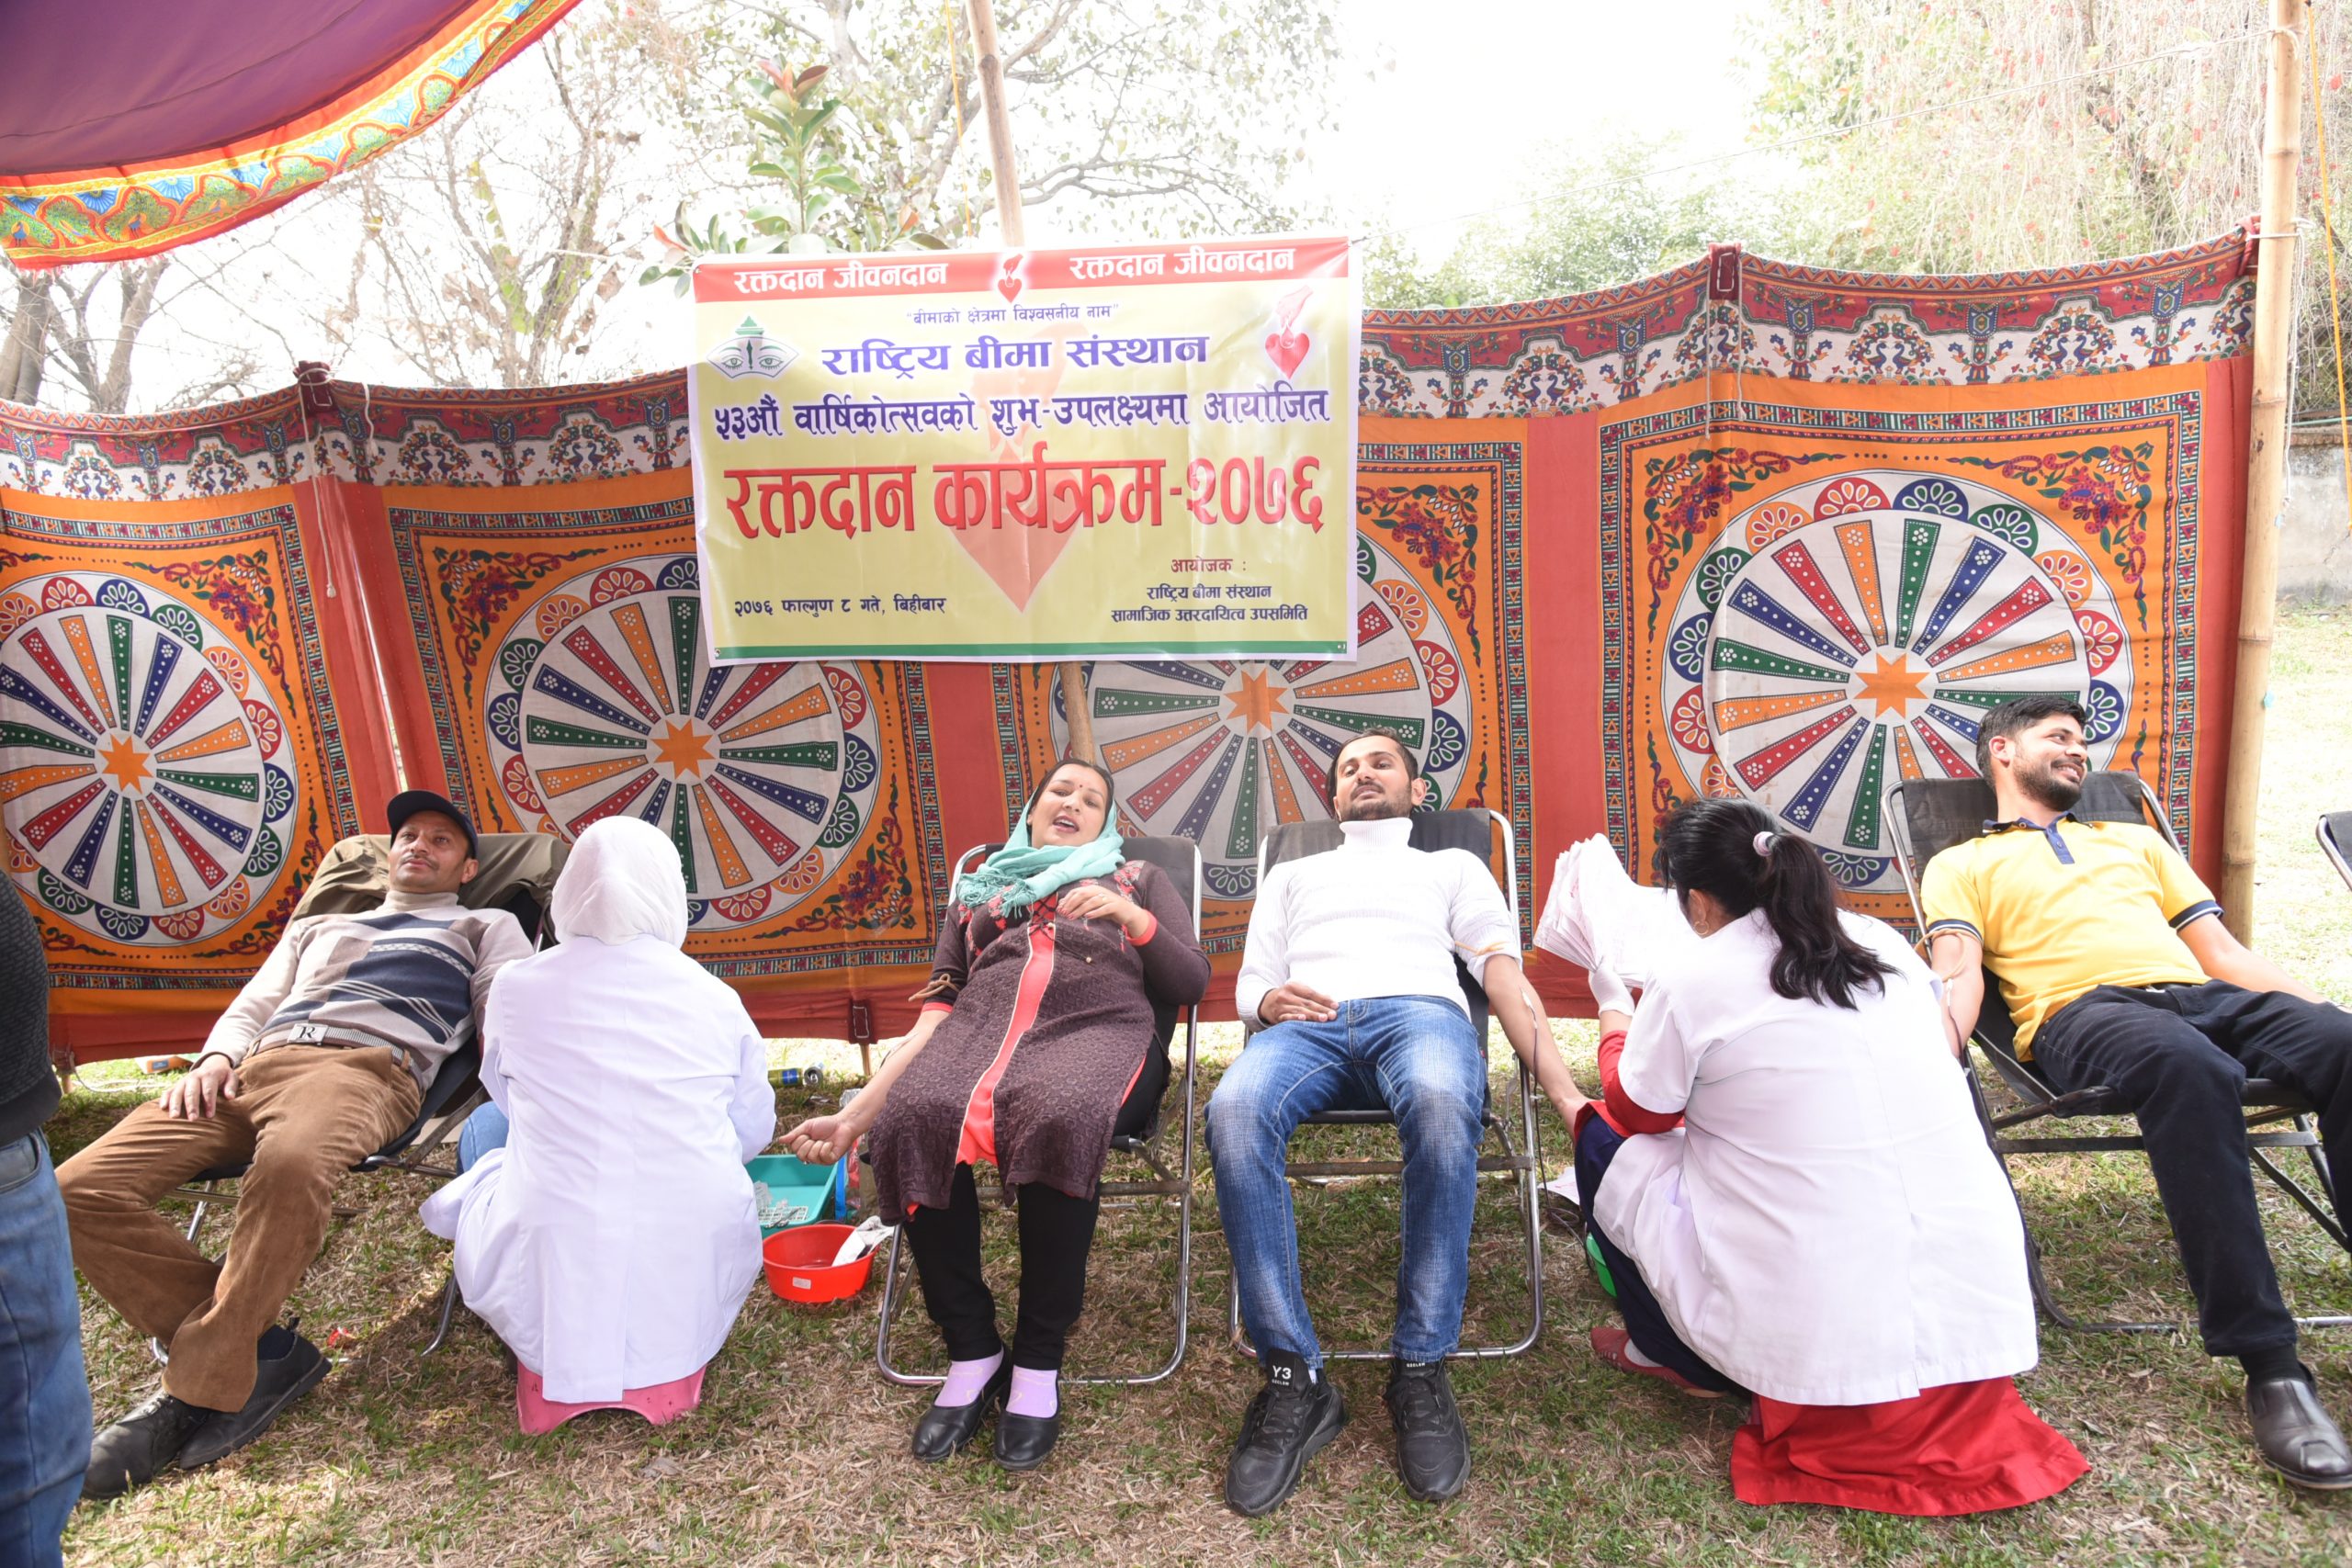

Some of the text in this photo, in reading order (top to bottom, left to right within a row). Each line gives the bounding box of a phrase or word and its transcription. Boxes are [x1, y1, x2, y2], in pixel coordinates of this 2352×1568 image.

[1069, 244, 1296, 280] रक्तदान जीवनदान
[733, 260, 948, 294] रक्तदान जीवनदान
[967, 306, 1007, 323] क्षेत्रमा
[1013, 302, 1080, 322] विश्वसनीय
[821, 333, 1211, 380] राष्ट्रिय बीमा संस्थान
[793, 392, 978, 437] वार्षिकोत्सवको
[1203, 380, 1331, 425] आयोजित
[723, 465, 917, 540] रक्तदान
[1170, 555, 1234, 573] आयोजक
[1147, 582, 1272, 603] राष्ट्रिय बीमा संस्थान
[734, 599, 774, 617] २०७६
[781, 598, 834, 618] फाल्गुण
[893, 593, 948, 615] बिहीबार
[1111, 604, 1309, 623] सामाजिक उत्तरदायित्व उपसमिति
[1272, 1365, 1292, 1380] Y3
